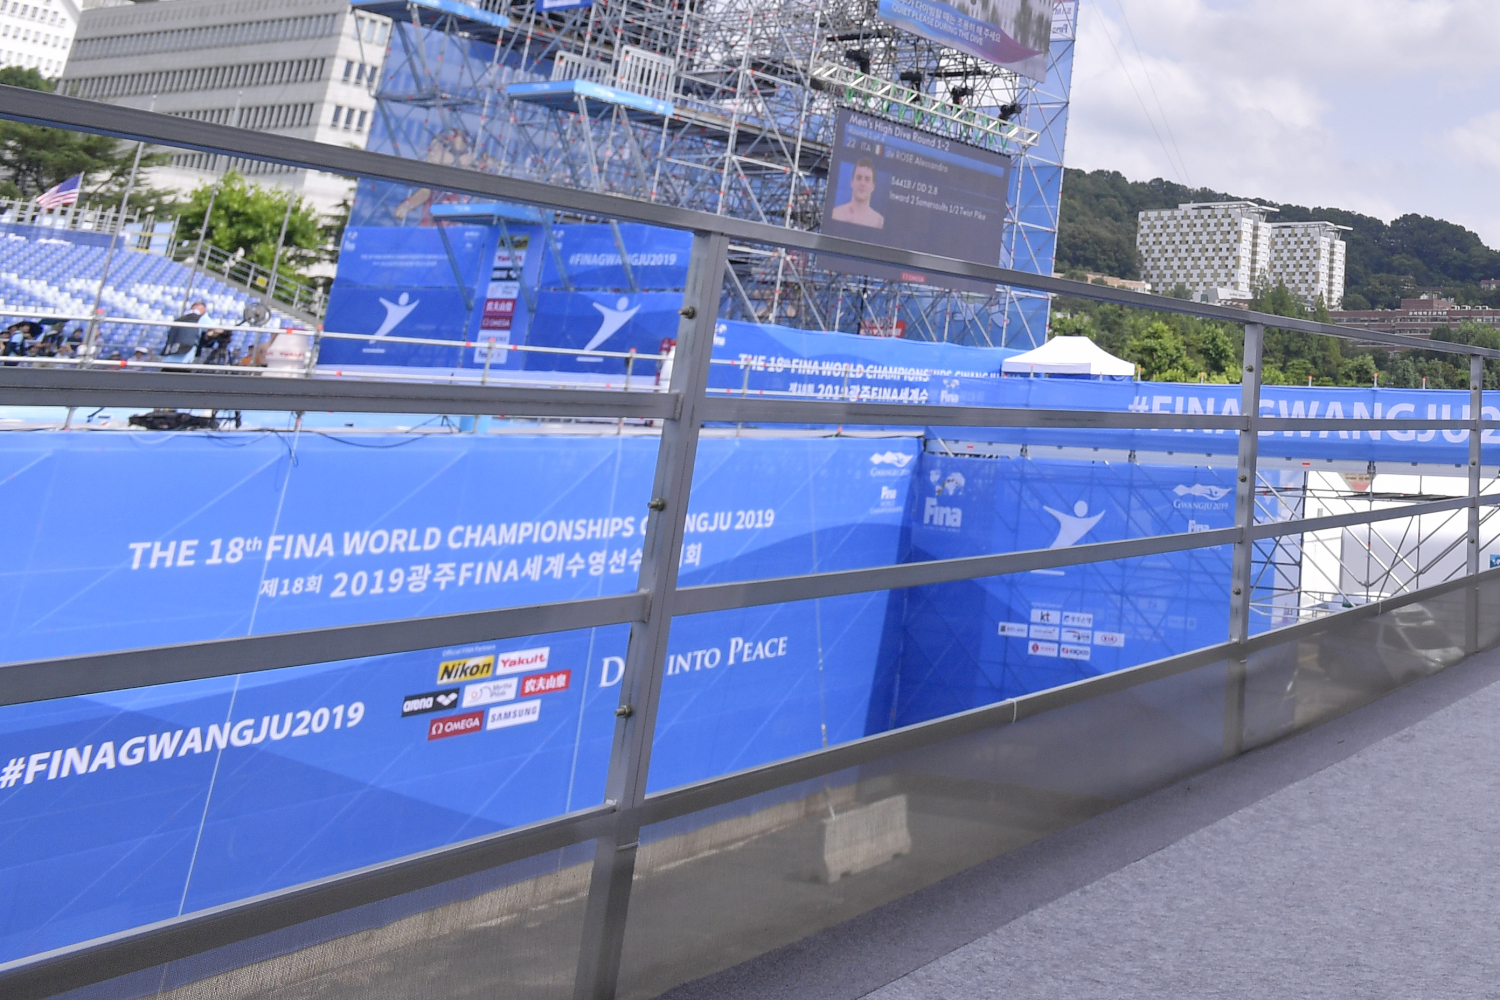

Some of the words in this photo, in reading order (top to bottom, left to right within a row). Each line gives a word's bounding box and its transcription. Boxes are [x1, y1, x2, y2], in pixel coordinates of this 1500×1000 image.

[892, 3, 912, 17] QUIET
[912, 10, 935, 27] PLEASE
[934, 18, 958, 36] DURING
[958, 29, 970, 41] THE
[969, 33, 983, 46] DIVE
[849, 115, 872, 131] Men's
[875, 121, 894, 136] High
[894, 126, 911, 140] Dive
[912, 132, 936, 147] Round
[937, 139, 950, 152] 1-2
[860, 143, 871, 153] ITA
[569, 253, 678, 266] #FINAGWAGJU2019
[791, 358, 820, 375] FINA
[923, 497, 963, 528] Fina
[1173, 499, 1212, 511] GWANGJU
[128, 539, 199, 570] THE
[205, 536, 262, 565] 18th
[265, 532, 335, 562] FINA
[343, 526, 442, 556] WORLD
[447, 516, 636, 549] CHAMPIONSHIPS
[734, 508, 775, 531] 2019
[259, 574, 323, 598] 제18회
[1040, 611, 1050, 622] kt
[501, 653, 546, 668] Yakult
[667, 647, 721, 676] INTO
[727, 636, 788, 666] PEACE
[440, 662, 491, 682] Nikon
[403, 697, 433, 713] arena
[490, 707, 537, 723] SAMSUNG
[444, 717, 480, 733] OMEGA
[0, 701, 365, 789] #FINAGWANGJU2019
